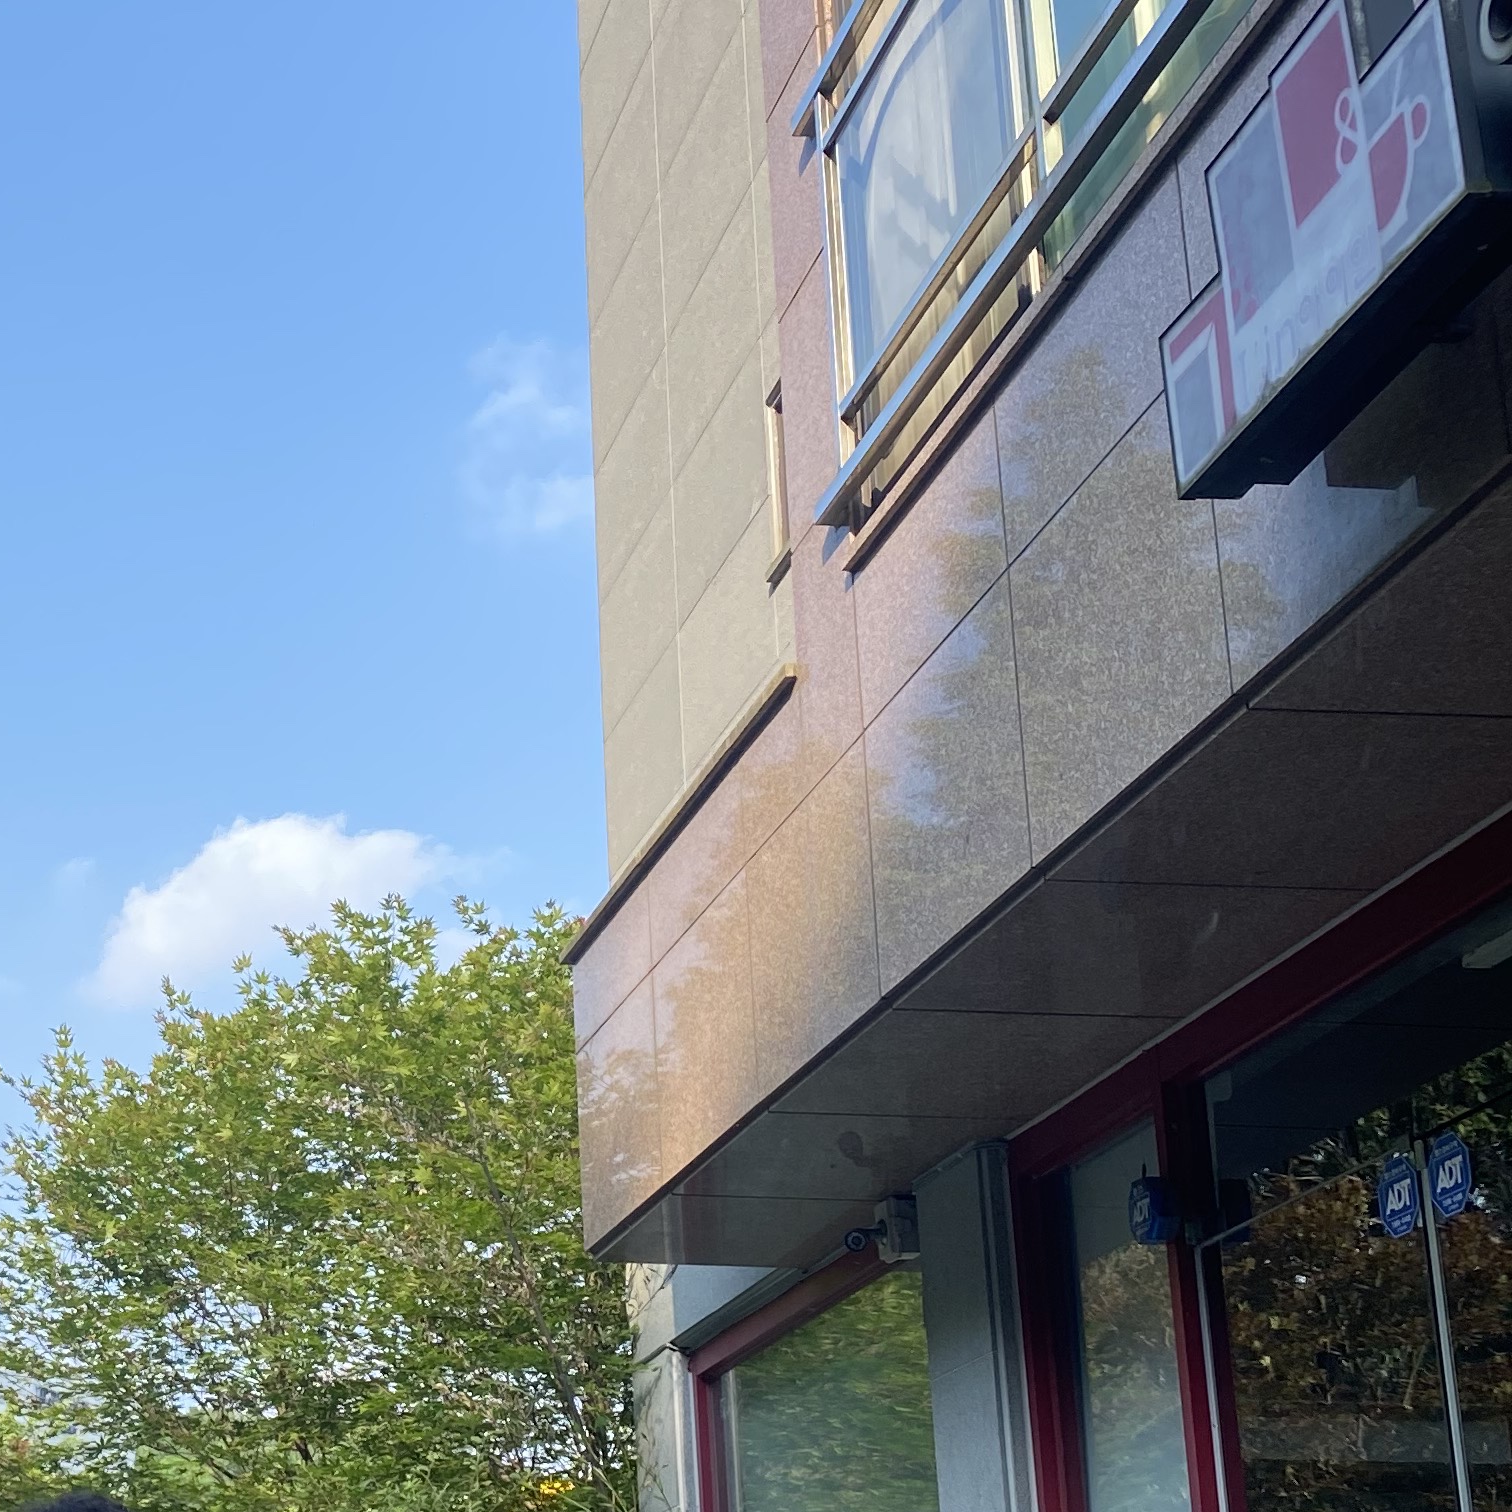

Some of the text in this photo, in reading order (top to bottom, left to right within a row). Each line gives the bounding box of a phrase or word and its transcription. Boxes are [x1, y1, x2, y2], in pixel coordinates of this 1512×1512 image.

[1437, 1154, 1463, 1193] ADT
[1133, 1198, 1150, 1225] ADT
[1386, 1178, 1411, 1215] ADT
